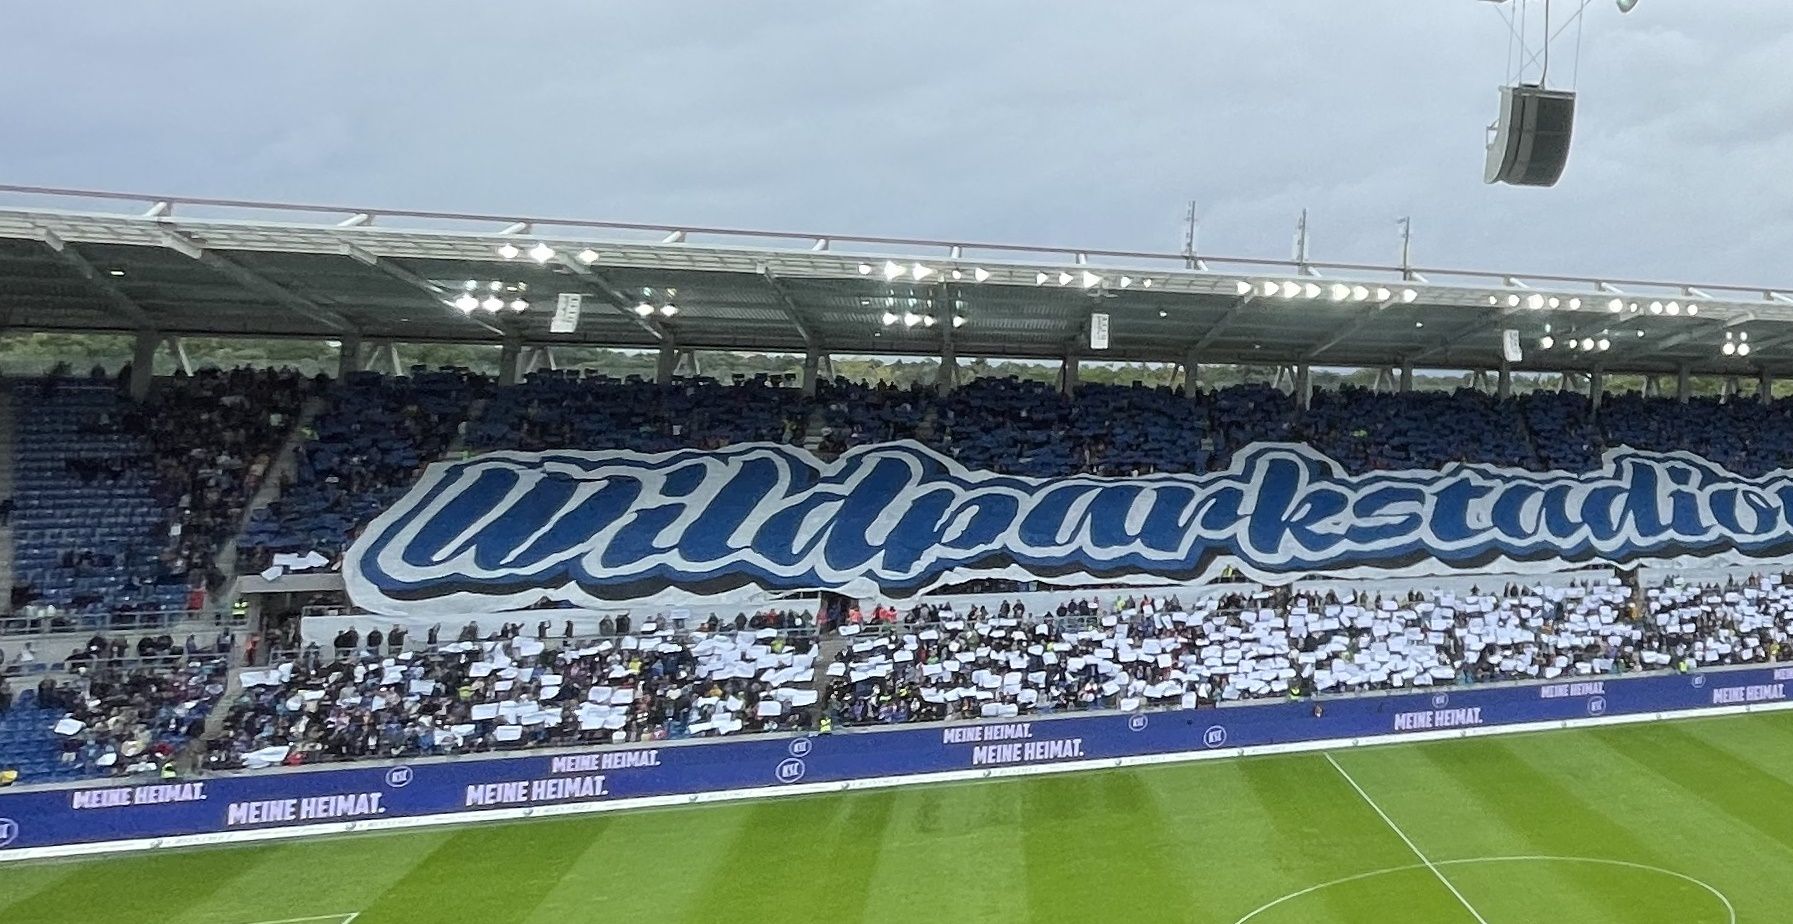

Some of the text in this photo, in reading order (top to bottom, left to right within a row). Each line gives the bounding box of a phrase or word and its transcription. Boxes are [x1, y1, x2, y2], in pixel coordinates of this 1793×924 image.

[943, 726, 983, 744] MEINE
[551, 750, 661, 773] MEINE HEIMAT.
[972, 738, 1084, 765] MEINE HEIMAT.
[72, 788, 132, 809] MEINE
[466, 775, 609, 806] MEINE HEIMAT.
[228, 792, 386, 825] MEINE HEIMAT.
